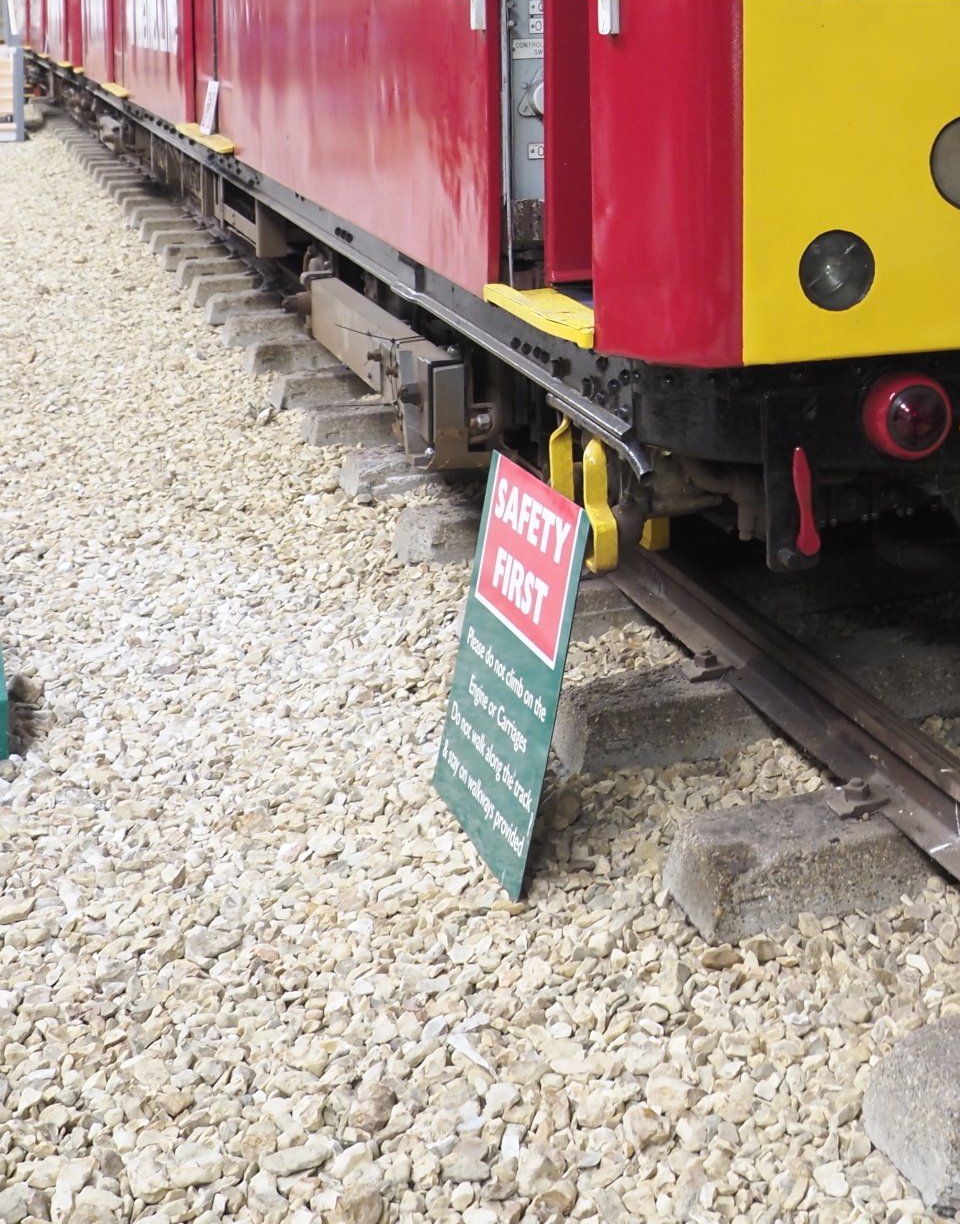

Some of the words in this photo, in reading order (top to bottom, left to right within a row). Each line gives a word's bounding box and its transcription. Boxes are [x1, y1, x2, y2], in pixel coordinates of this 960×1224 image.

[494, 478, 571, 565] SAFETY
[492, 545, 549, 625] FIRST
[466, 626, 486, 659] Please
[485, 645, 494, 668] do
[494, 658, 506, 681] not
[505, 668, 523, 698] climb
[523, 690, 534, 710] on
[533, 695, 547, 723] the
[468, 673, 489, 710] Engine
[488, 701, 498, 718] or
[496, 705, 527, 753] Carriages
[442, 738, 449, 760] &
[447, 749, 460, 777] stay
[458, 764, 468, 785] on
[467, 775, 495, 820] walkways
[493, 810, 525, 858] provided
[450, 700, 461, 726] Do
[460, 717, 472, 740] not
[471, 729, 486, 756] walk
[484, 743, 503, 782] along
[501, 763, 514, 791] the
[513, 779, 533, 813] track
